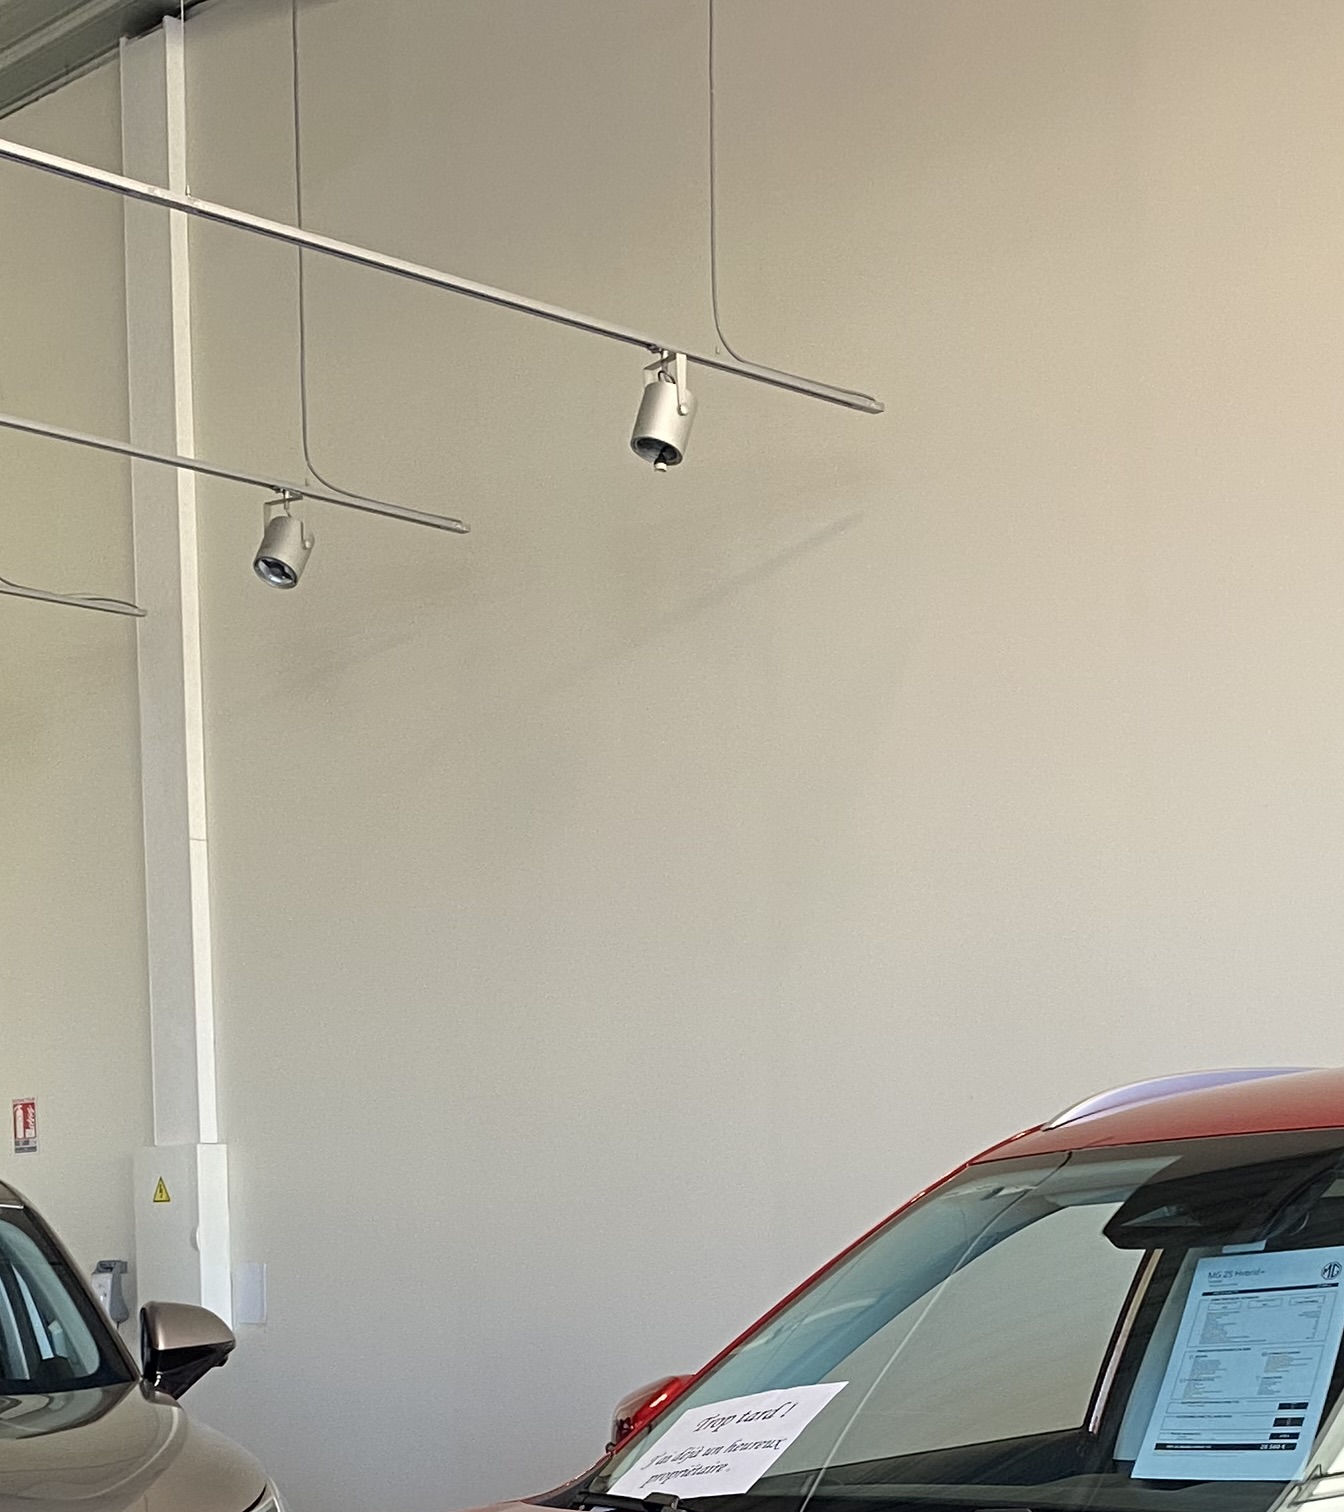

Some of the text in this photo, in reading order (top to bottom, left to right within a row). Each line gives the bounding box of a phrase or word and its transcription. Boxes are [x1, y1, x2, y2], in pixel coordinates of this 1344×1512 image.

[1321, 1261, 1342, 1281] MG
[693, 1413, 737, 1433] Trop
[736, 1401, 792, 1424] tard
[702, 1444, 725, 1457] un
[723, 1437, 788, 1455] heureux
